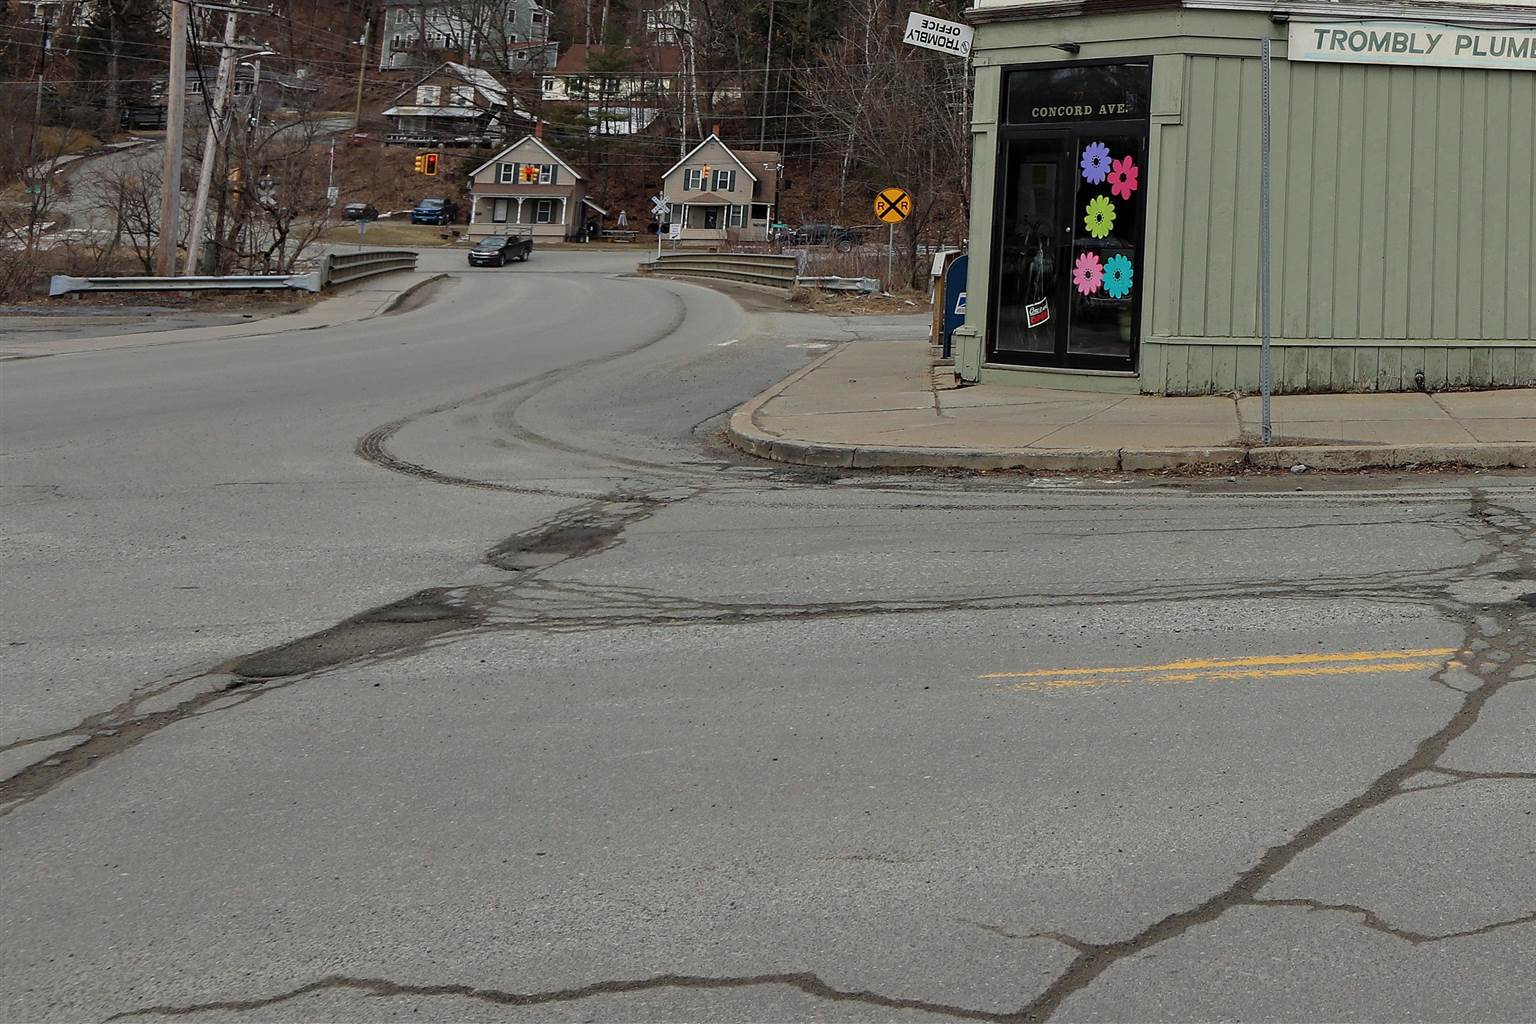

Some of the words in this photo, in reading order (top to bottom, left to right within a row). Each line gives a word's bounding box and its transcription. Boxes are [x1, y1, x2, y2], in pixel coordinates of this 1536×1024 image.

[921, 19, 961, 36] OFFICE
[906, 28, 960, 51] TROMBLY
[1314, 28, 1443, 55] TROMBLY
[1031, 105, 1093, 118] CONCORD
[1098, 103, 1129, 115] AVE.
[877, 201, 885, 211] R
[900, 201, 908, 211] R
